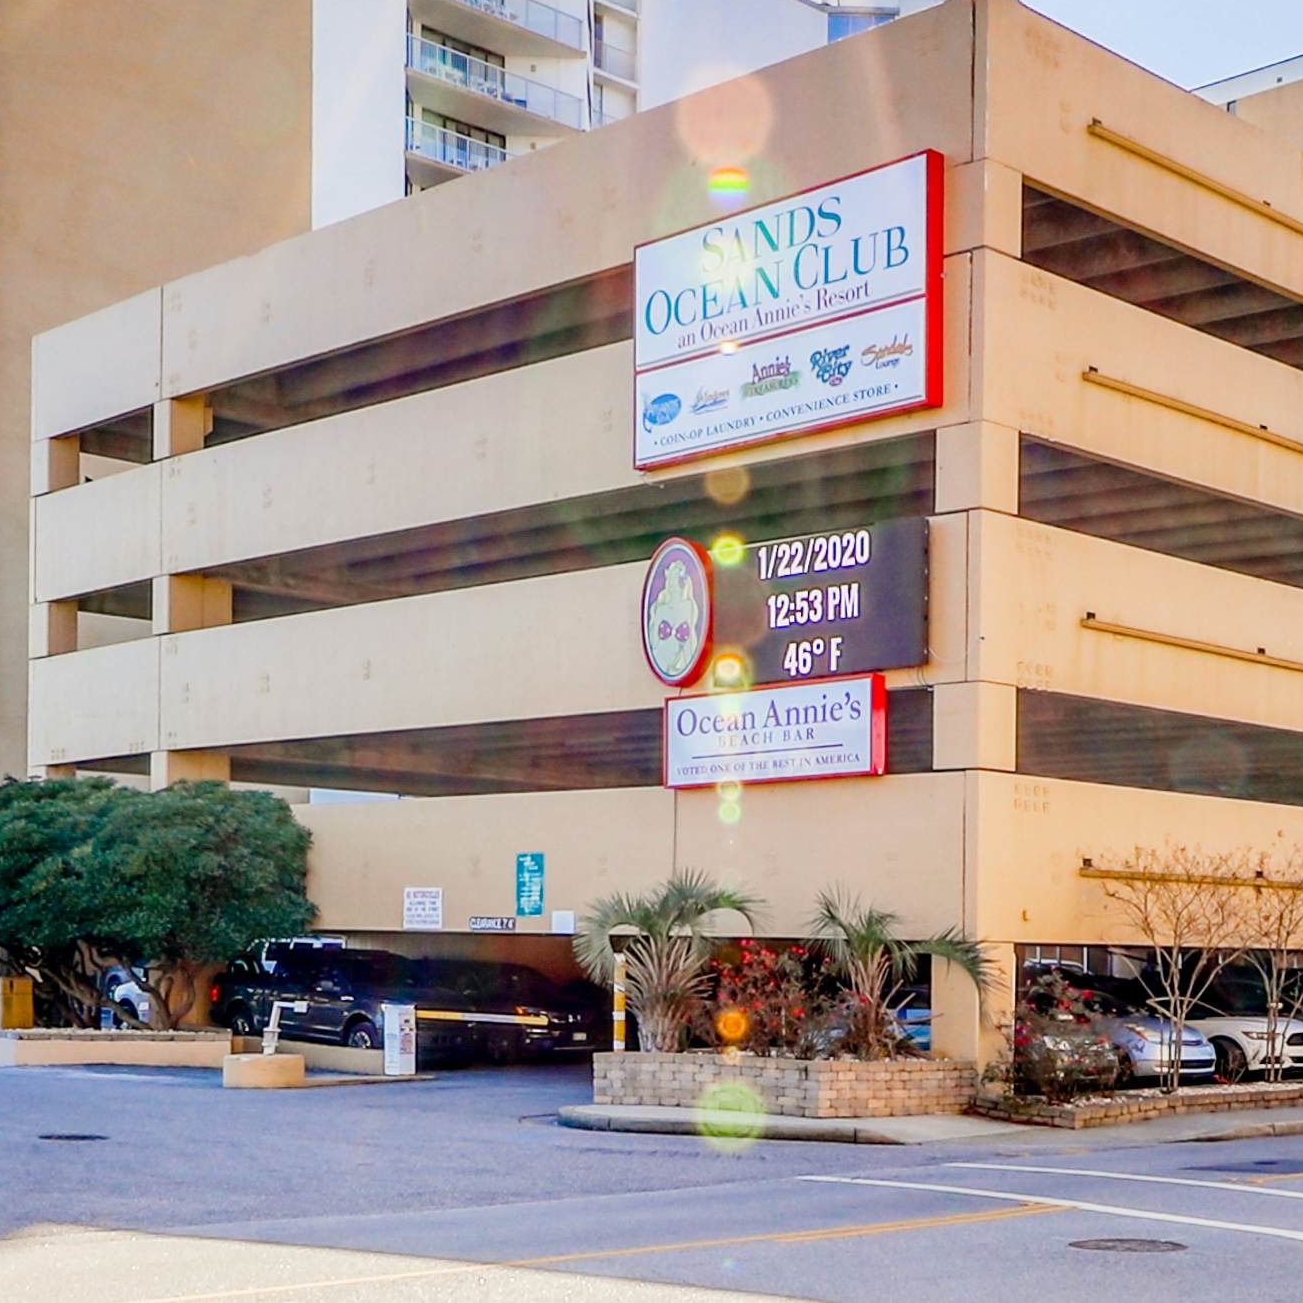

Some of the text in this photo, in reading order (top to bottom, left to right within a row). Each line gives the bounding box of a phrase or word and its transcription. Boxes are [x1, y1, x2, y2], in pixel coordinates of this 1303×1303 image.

[702, 196, 842, 273] SANDS
[644, 225, 910, 336] OCEAN CLUB
[678, 281, 871, 349] an Ocean Annie's Resort
[810, 344, 851, 372] River
[816, 359, 853, 384] City
[659, 383, 892, 447] COIN-OP LAUNDRY CONVENIENCE STORE
[758, 530, 870, 581] 1/22/2020
[767, 583, 860, 629] 12:53 PM
[829, 637, 843, 672] F
[676, 691, 863, 738] Ocean Annie's
[718, 726, 816, 749] BEACH BAR
[676, 752, 861, 776] VOTED ONE OF THE BEST IN AMERICA
